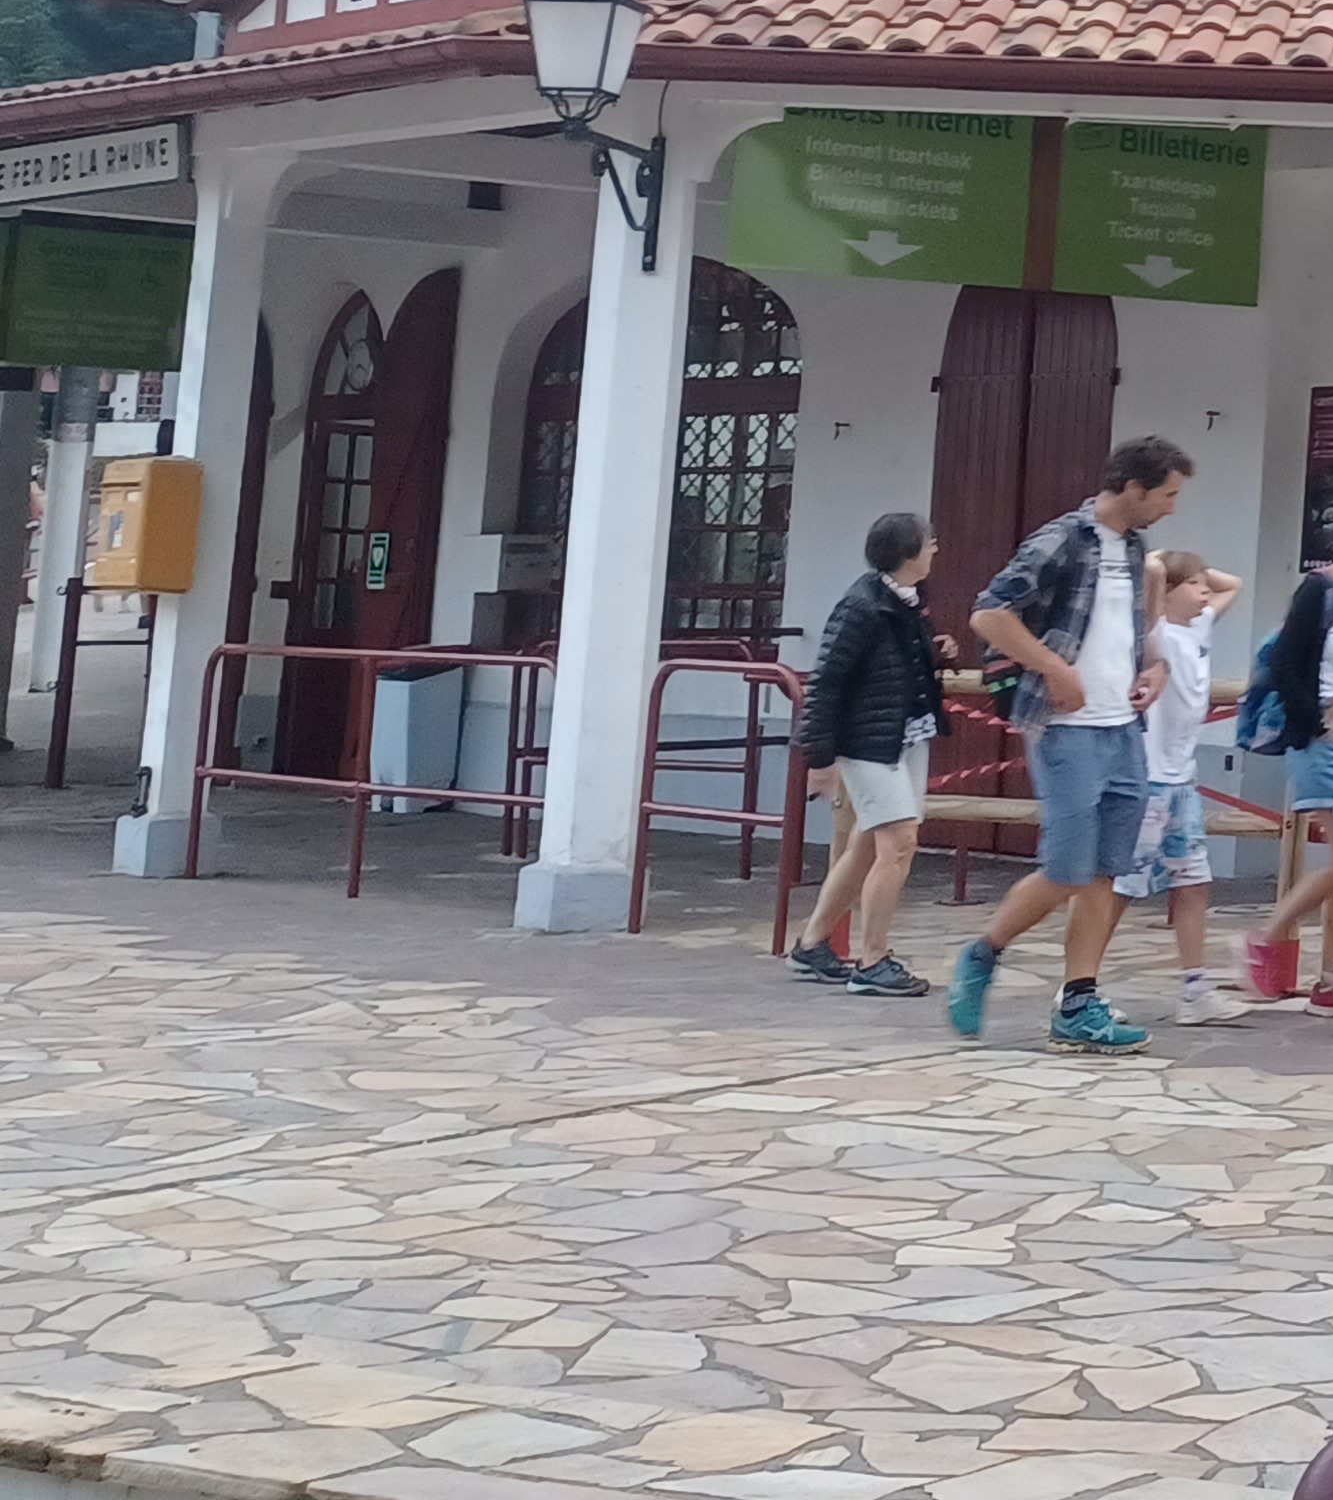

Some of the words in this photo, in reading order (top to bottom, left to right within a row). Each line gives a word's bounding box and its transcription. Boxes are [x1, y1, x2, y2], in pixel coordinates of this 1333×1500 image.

[12, 158, 43, 188] FER
[50, 153, 71, 182] DE
[78, 148, 99, 178] LA
[105, 137, 168, 174] RHUNE
[1119, 126, 1250, 166] Billetterie
